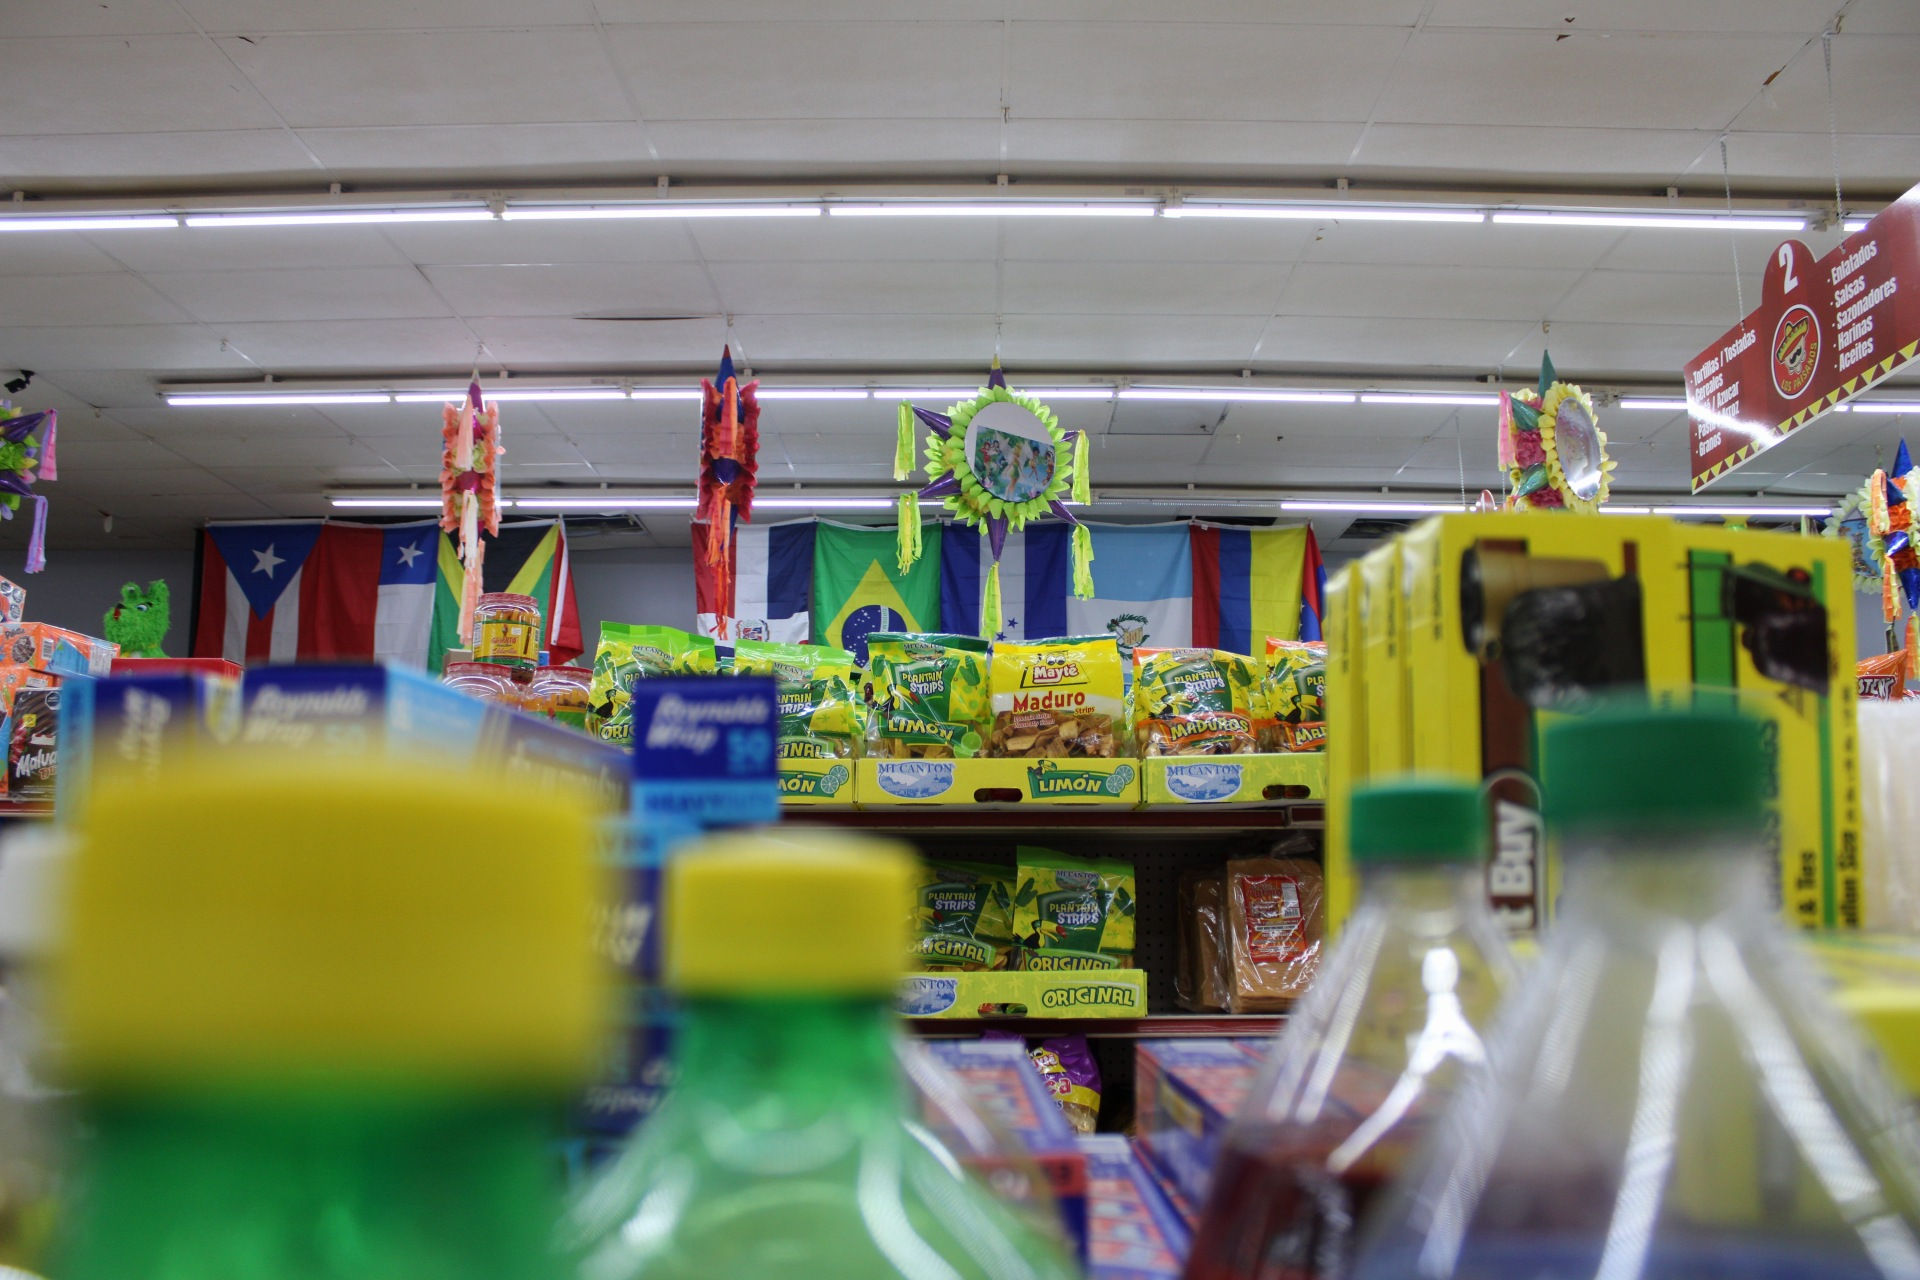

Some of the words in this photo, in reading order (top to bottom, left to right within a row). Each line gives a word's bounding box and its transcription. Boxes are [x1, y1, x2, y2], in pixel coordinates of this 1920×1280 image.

[1778, 243, 1799, 294] 2
[1831, 240, 1877, 286] Enlatados
[1834, 275, 1866, 308] Salsas
[1836, 276, 1897, 330] Sazonadores
[1838, 315, 1873, 351] Harinas
[1693, 357, 1720, 386] Tortillas
[1724, 329, 1757, 363] Tostadas
[1839, 337, 1874, 372] Aceites
[1699, 432, 1722, 457] Granos
[902, 671, 943, 683] PLANTAIN
[1032, 663, 1080, 684] Mayté
[1174, 671, 1221, 684] PLANTAIN
[909, 680, 945, 695] STRIPS
[1185, 677, 1226, 692] STRIPS
[776, 703, 812, 714] TRIPS
[1013, 690, 1086, 713] Maduro
[1171, 717, 1249, 741] MADUROS
[878, 763, 896, 773] MI
[899, 763, 953, 773] CANTON
[1167, 765, 1185, 776] MI
[1188, 764, 1240, 775] CANTON
[928, 892, 976, 901] PLANTAIN
[935, 900, 976, 911] STRIPS
[1050, 903, 1098, 913] PLANTAIN
[1058, 912, 1099, 924] STRIPS
[903, 979, 955, 990] ANTON
[1042, 986, 1135, 1008] ORIGINAL
